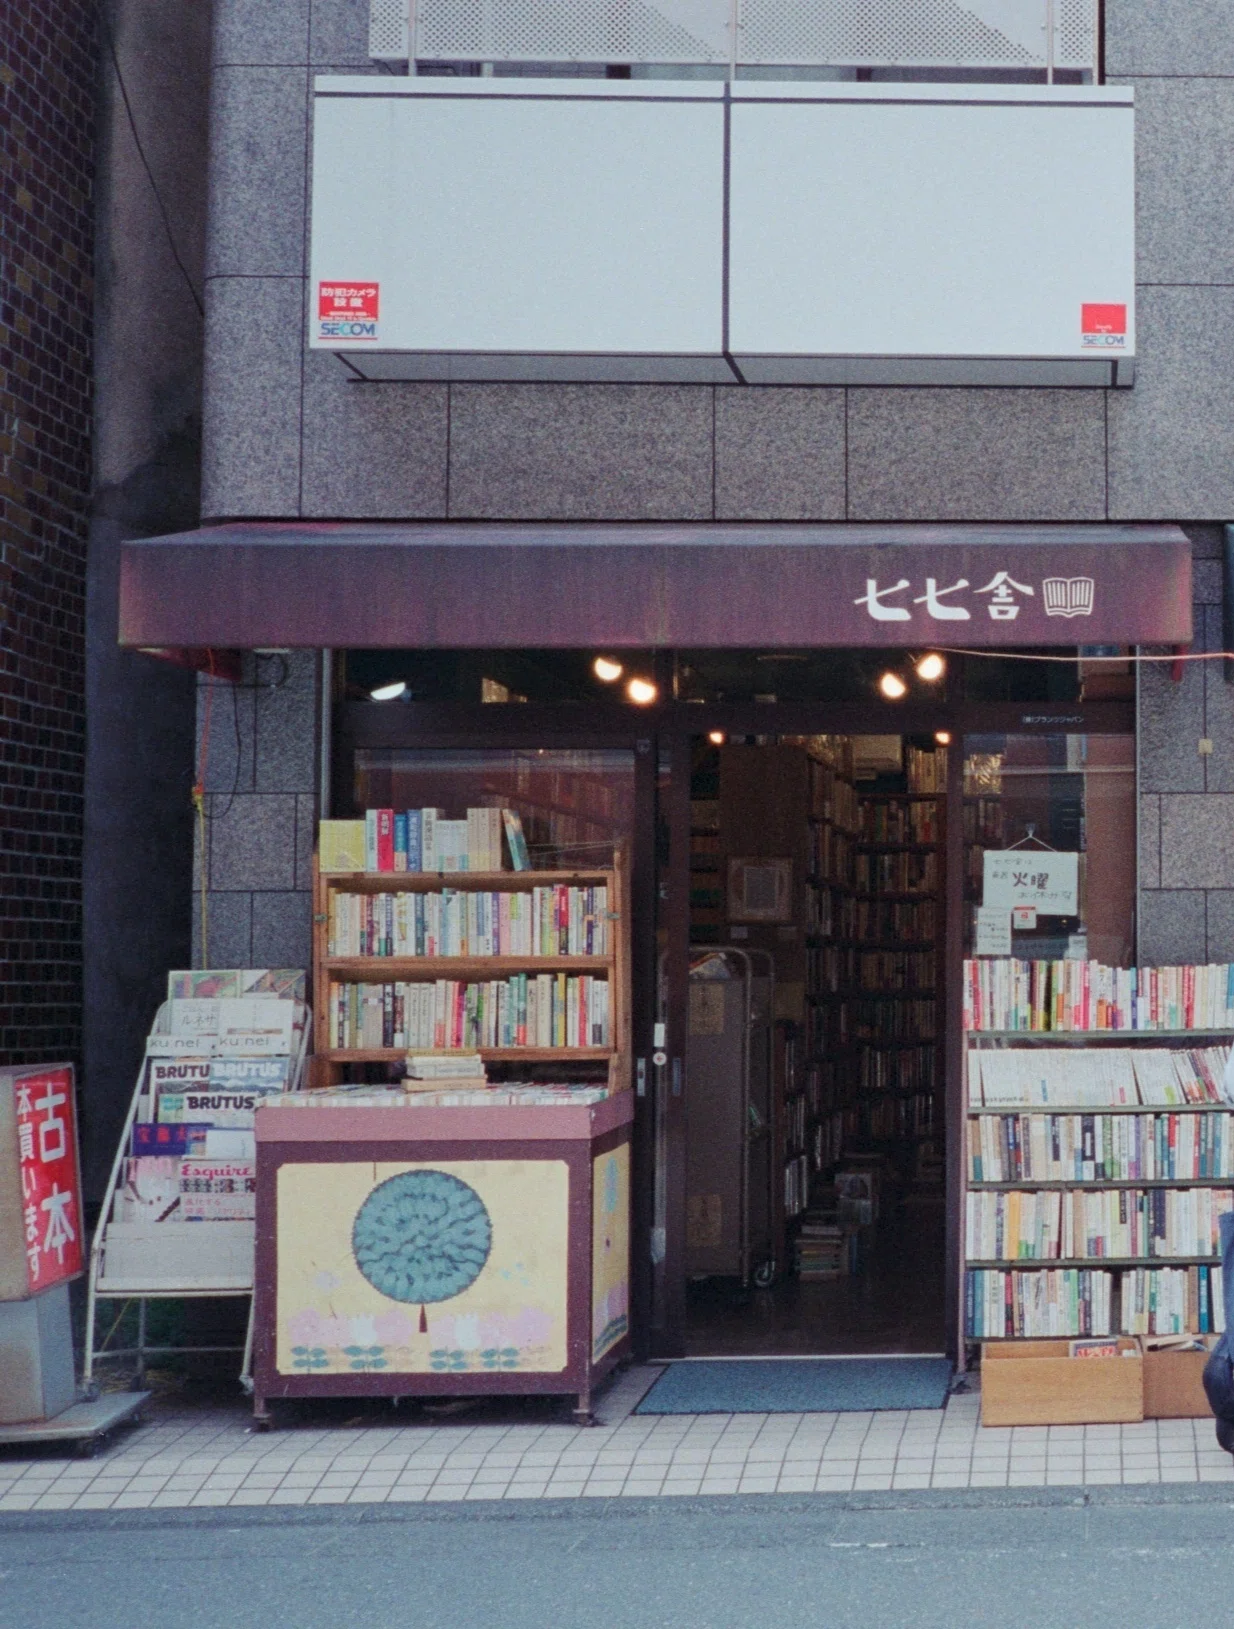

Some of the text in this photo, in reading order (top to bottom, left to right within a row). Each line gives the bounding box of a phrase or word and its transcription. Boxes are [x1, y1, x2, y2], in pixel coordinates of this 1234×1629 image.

[321, 287, 376, 297] 防犯カメラ
[321, 323, 375, 336] SECOM
[1083, 335, 1124, 345] SECOM
[854, 571, 1034, 621] 七七舎
[1012, 871, 1049, 890] 火曜
[155, 1063, 210, 1079] BRUTU
[213, 1062, 281, 1077] BRUTUS
[187, 1095, 255, 1110] BRUTUS
[35, 1083, 75, 1265] 古本
[181, 1163, 251, 1181] Esquire
[17, 1084, 41, 1281] 本買います
